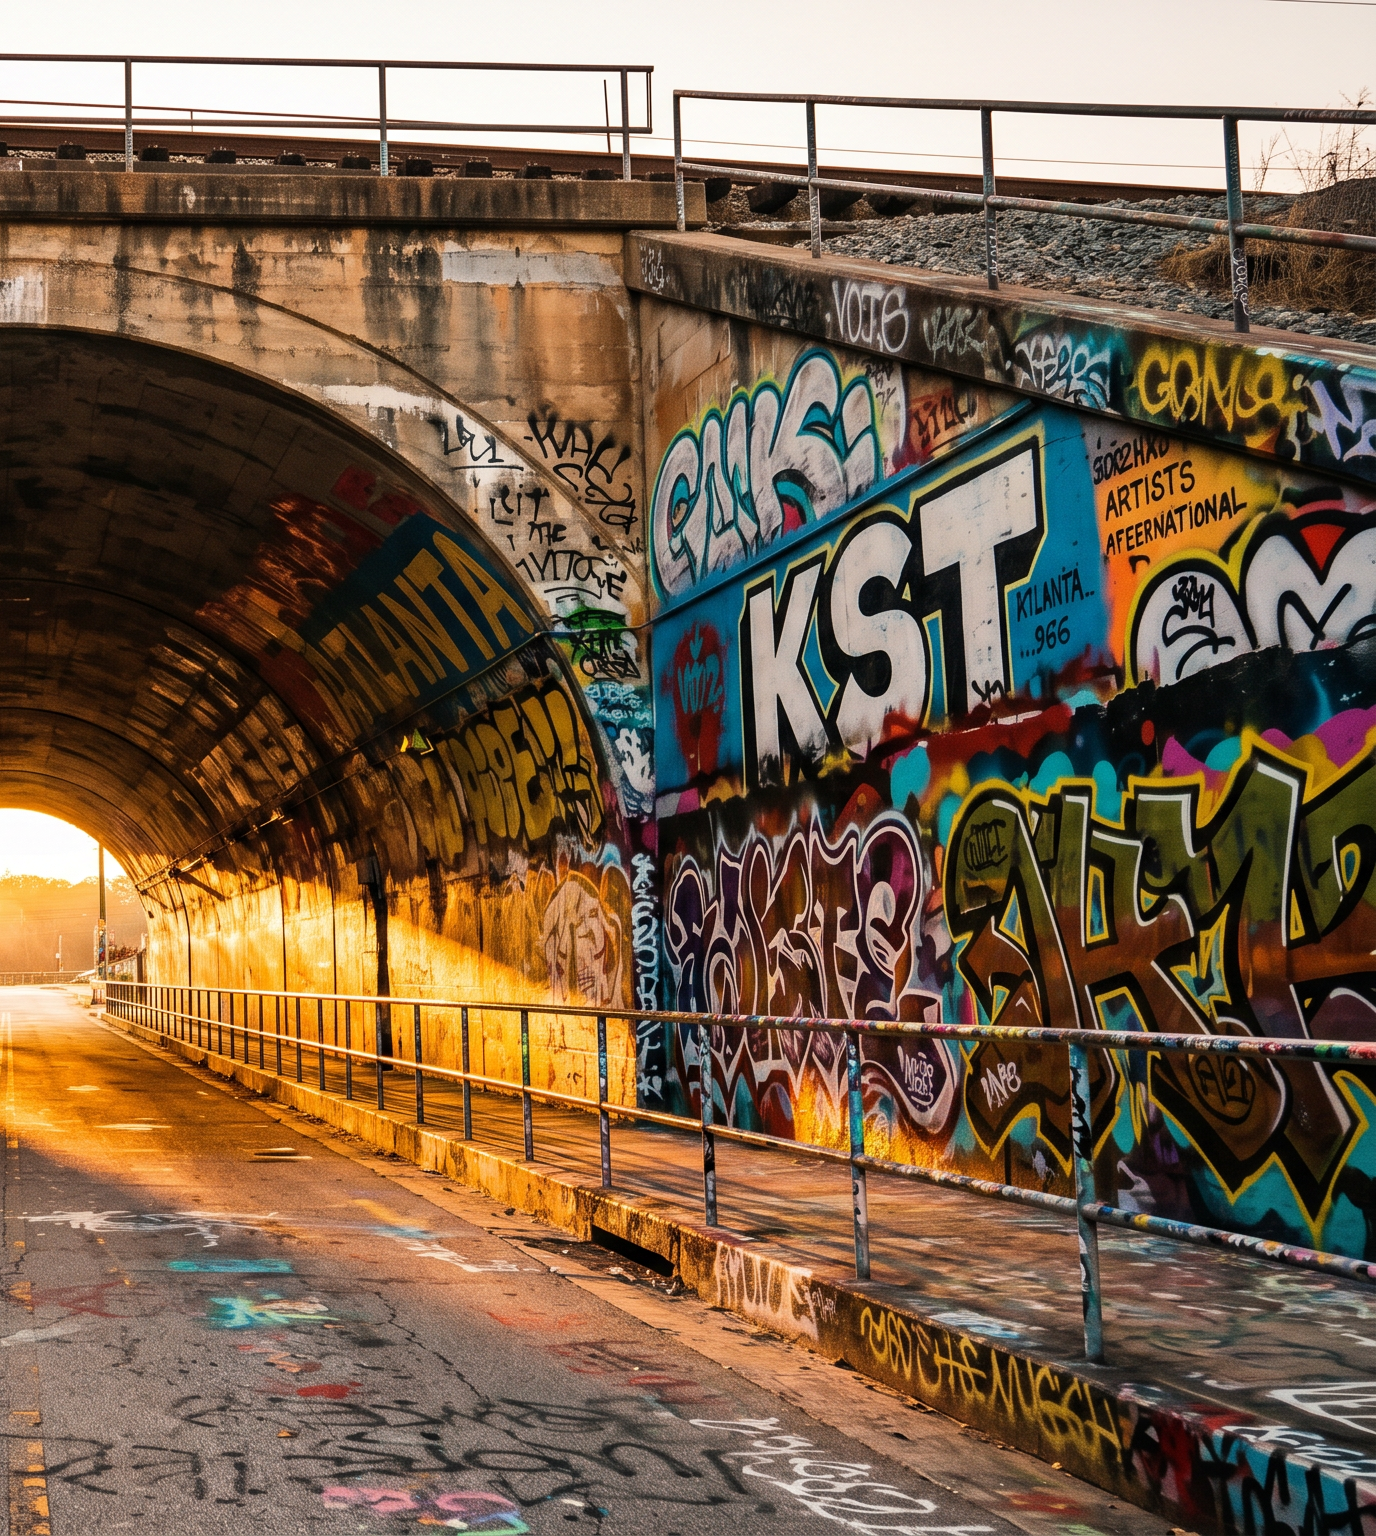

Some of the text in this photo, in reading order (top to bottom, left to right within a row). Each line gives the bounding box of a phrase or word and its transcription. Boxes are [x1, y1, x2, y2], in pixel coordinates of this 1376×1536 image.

[1105, 460, 1196, 522] ARTISTS
[1105, 486, 1247, 556] AFEERNATIONAL
[317, 530, 535, 752] ATLANTA
[744, 445, 1042, 792] KST
